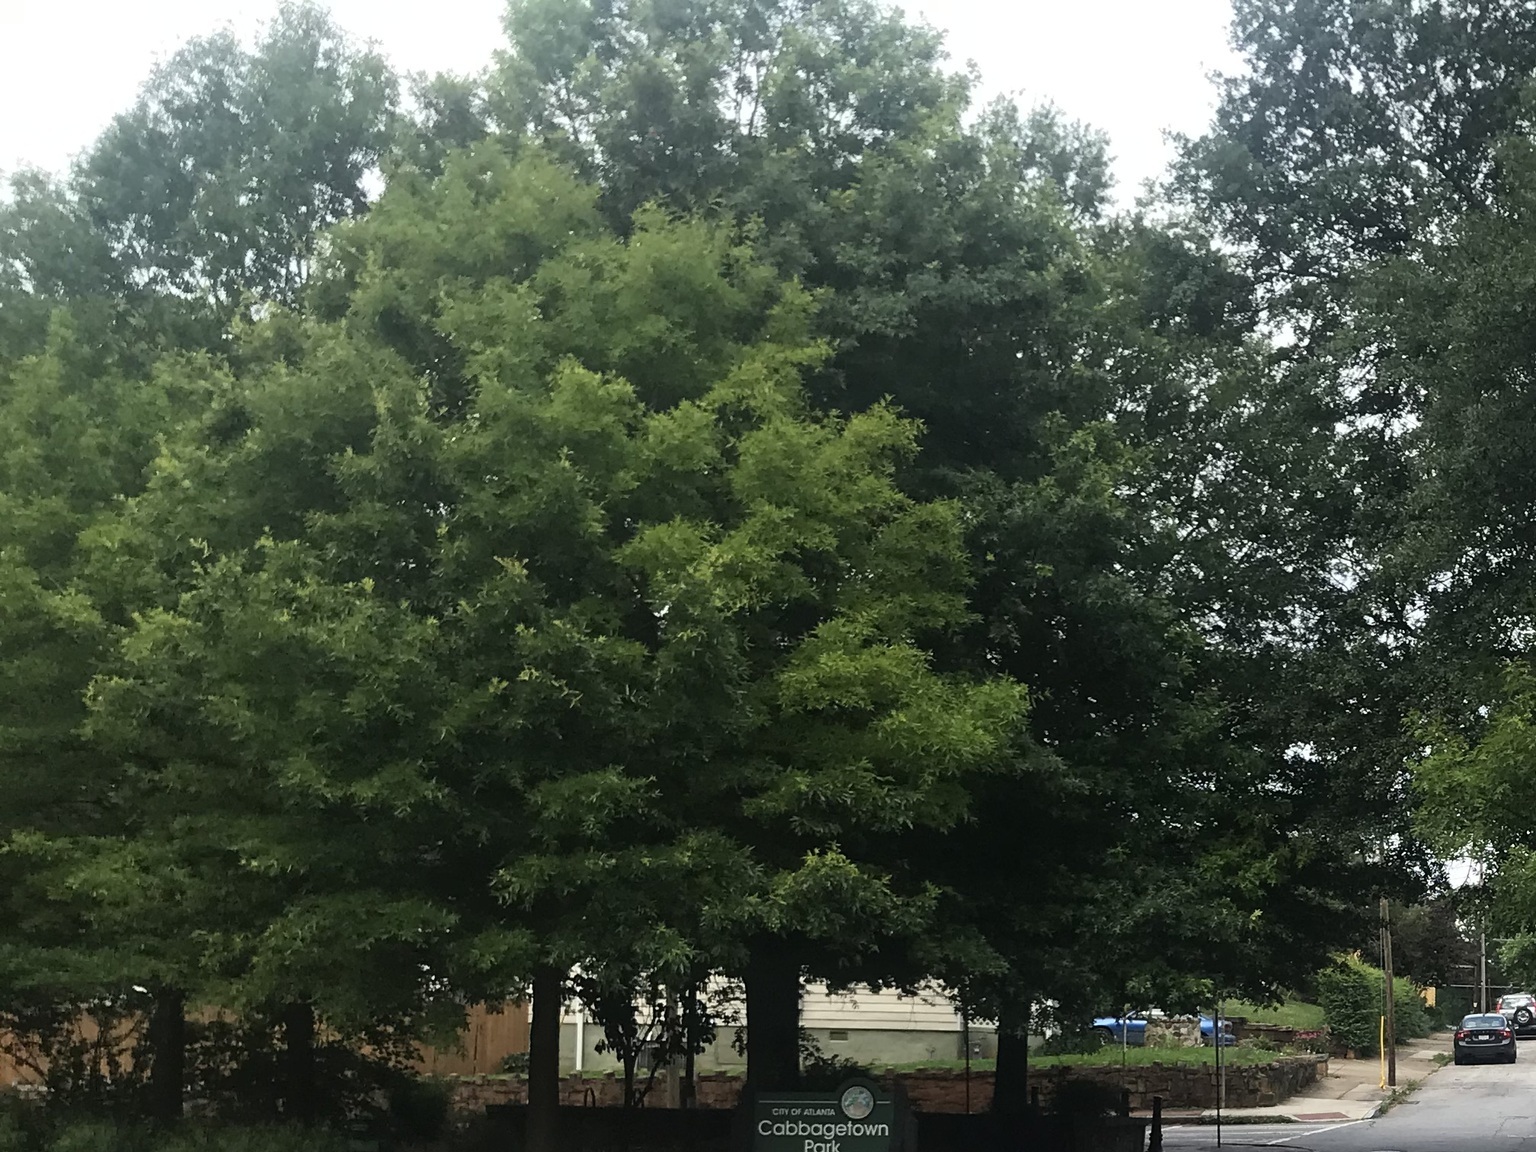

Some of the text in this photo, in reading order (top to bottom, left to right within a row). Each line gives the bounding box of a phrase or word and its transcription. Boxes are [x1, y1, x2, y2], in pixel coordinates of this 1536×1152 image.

[772, 1108, 835, 1116] CITY OF ATLANTA
[758, 1120, 889, 1140] Cabbagetown
